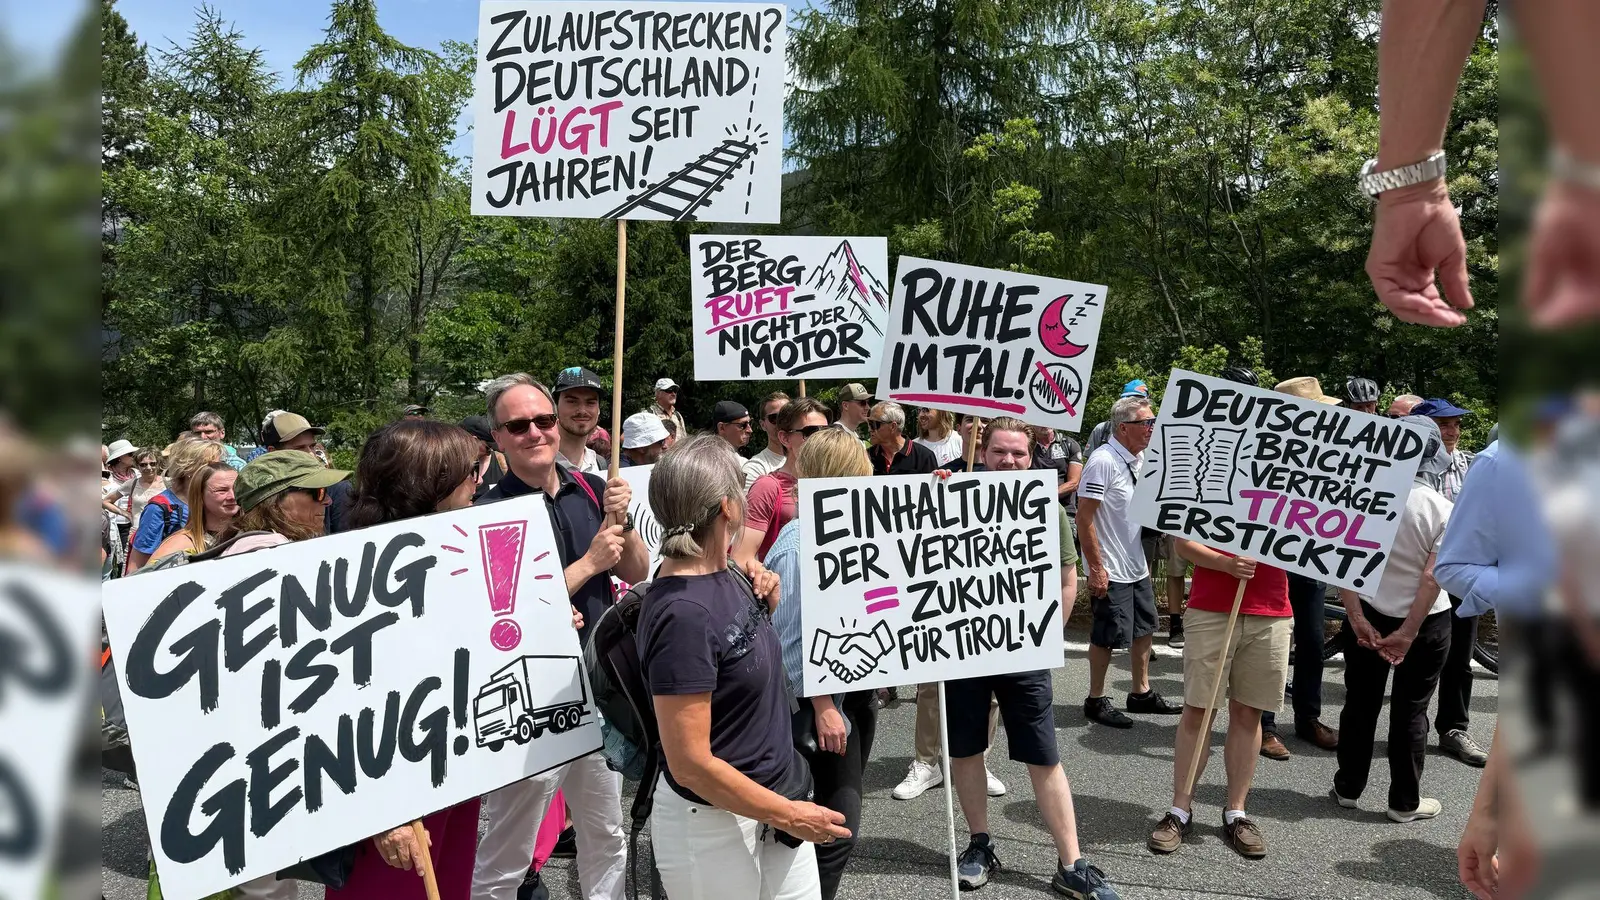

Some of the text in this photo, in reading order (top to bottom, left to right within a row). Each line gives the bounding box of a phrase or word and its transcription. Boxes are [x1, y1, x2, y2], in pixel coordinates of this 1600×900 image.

[486, 8, 782, 61] ZULAUFSTRECKEN?
[492, 56, 750, 113] DEUTSCHLAND
[501, 100, 700, 160] LÜGT SEIT
[486, 145, 654, 208] JAHREN!
[699, 239, 767, 268] DER
[703, 255, 806, 298] BERG
[718, 306, 848, 356] NICHT DER
[901, 268, 1040, 344] RUHE
[740, 323, 871, 378] MOTOR
[889, 342, 1035, 399] IM TAL!
[1172, 379, 1423, 461] DEUTSCHLAND
[1254, 432, 1392, 483] BRICHT
[813, 479, 1051, 546] EINHALTUNG
[1239, 490, 1381, 549] TIROL
[1251, 461, 1397, 521] VERTRÄGE,
[814, 526, 1048, 591] DER VERTRÄGE
[1156, 503, 1386, 589] ERSTICKT!
[126, 532, 437, 714] GENUG
[907, 563, 1053, 623] ZUKUNFT
[261, 610, 400, 730] IST
[897, 625, 950, 670] FÜR
[160, 648, 470, 876] GENUG!
